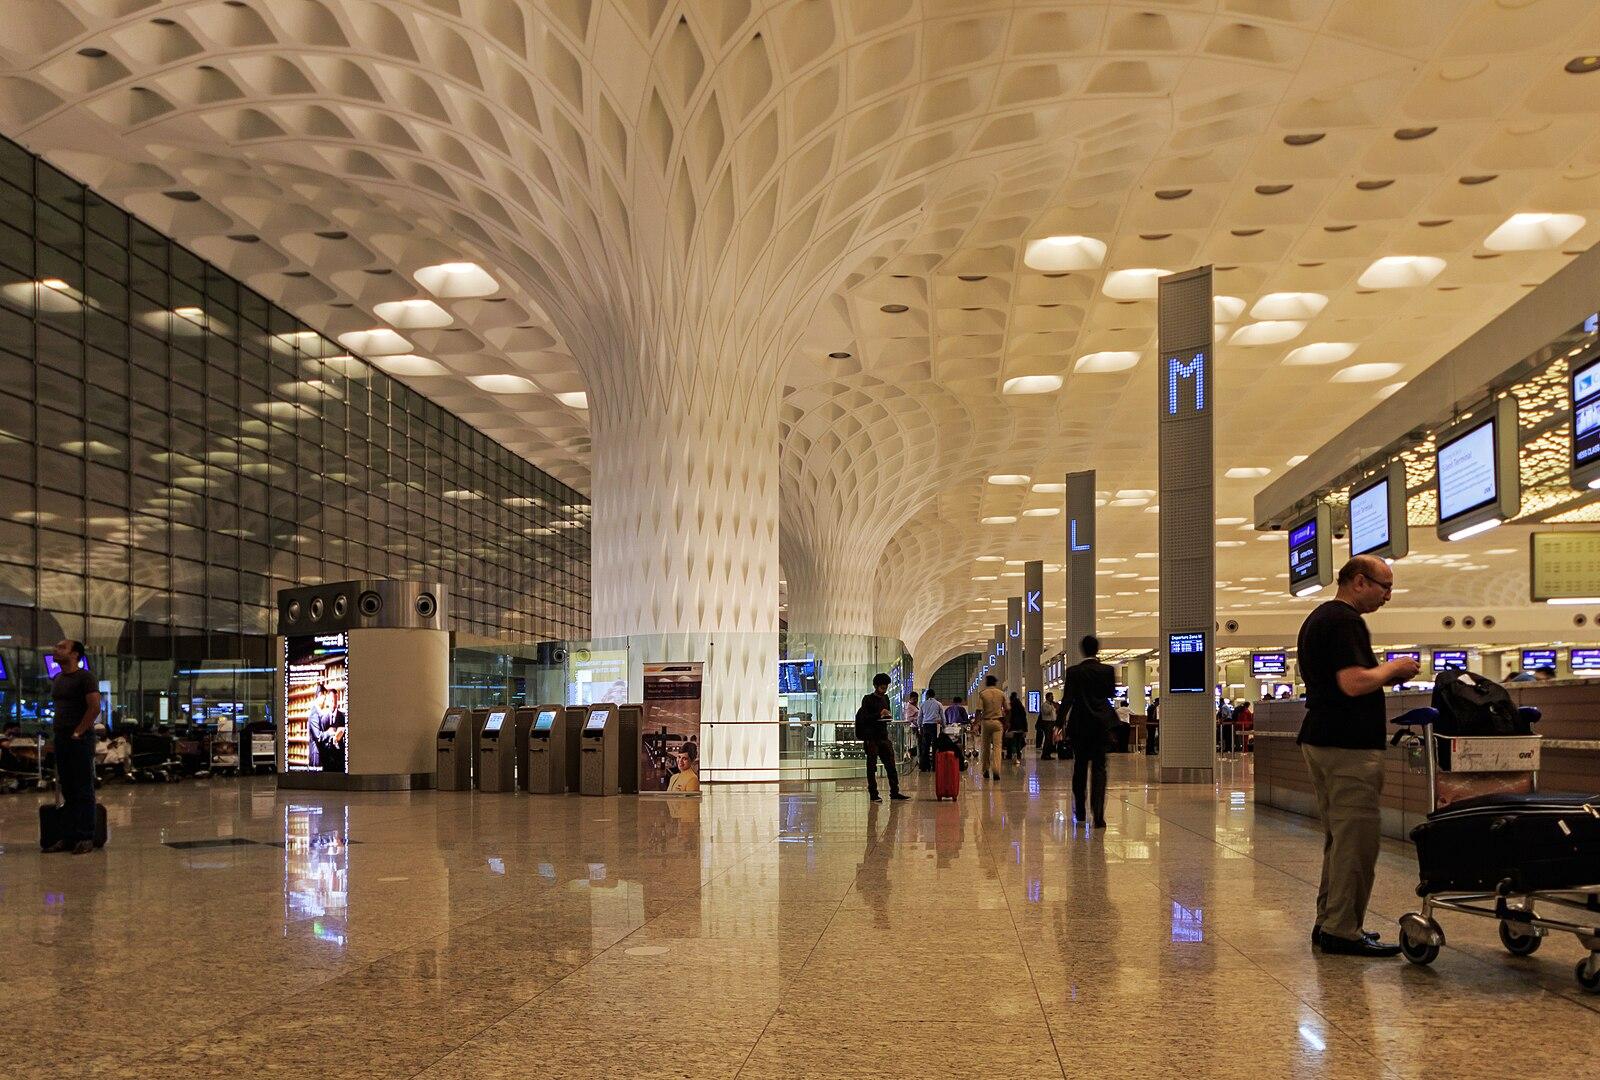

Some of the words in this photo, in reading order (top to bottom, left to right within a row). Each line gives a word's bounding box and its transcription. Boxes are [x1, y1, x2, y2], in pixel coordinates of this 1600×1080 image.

[1169, 353, 1203, 414] M
[1072, 519, 1090, 551] L
[1027, 590, 1041, 613] K
[1010, 620, 1020, 637] J
[996, 642, 1005, 656] H
[989, 654, 996, 666] G
[982, 665, 989, 675] F
